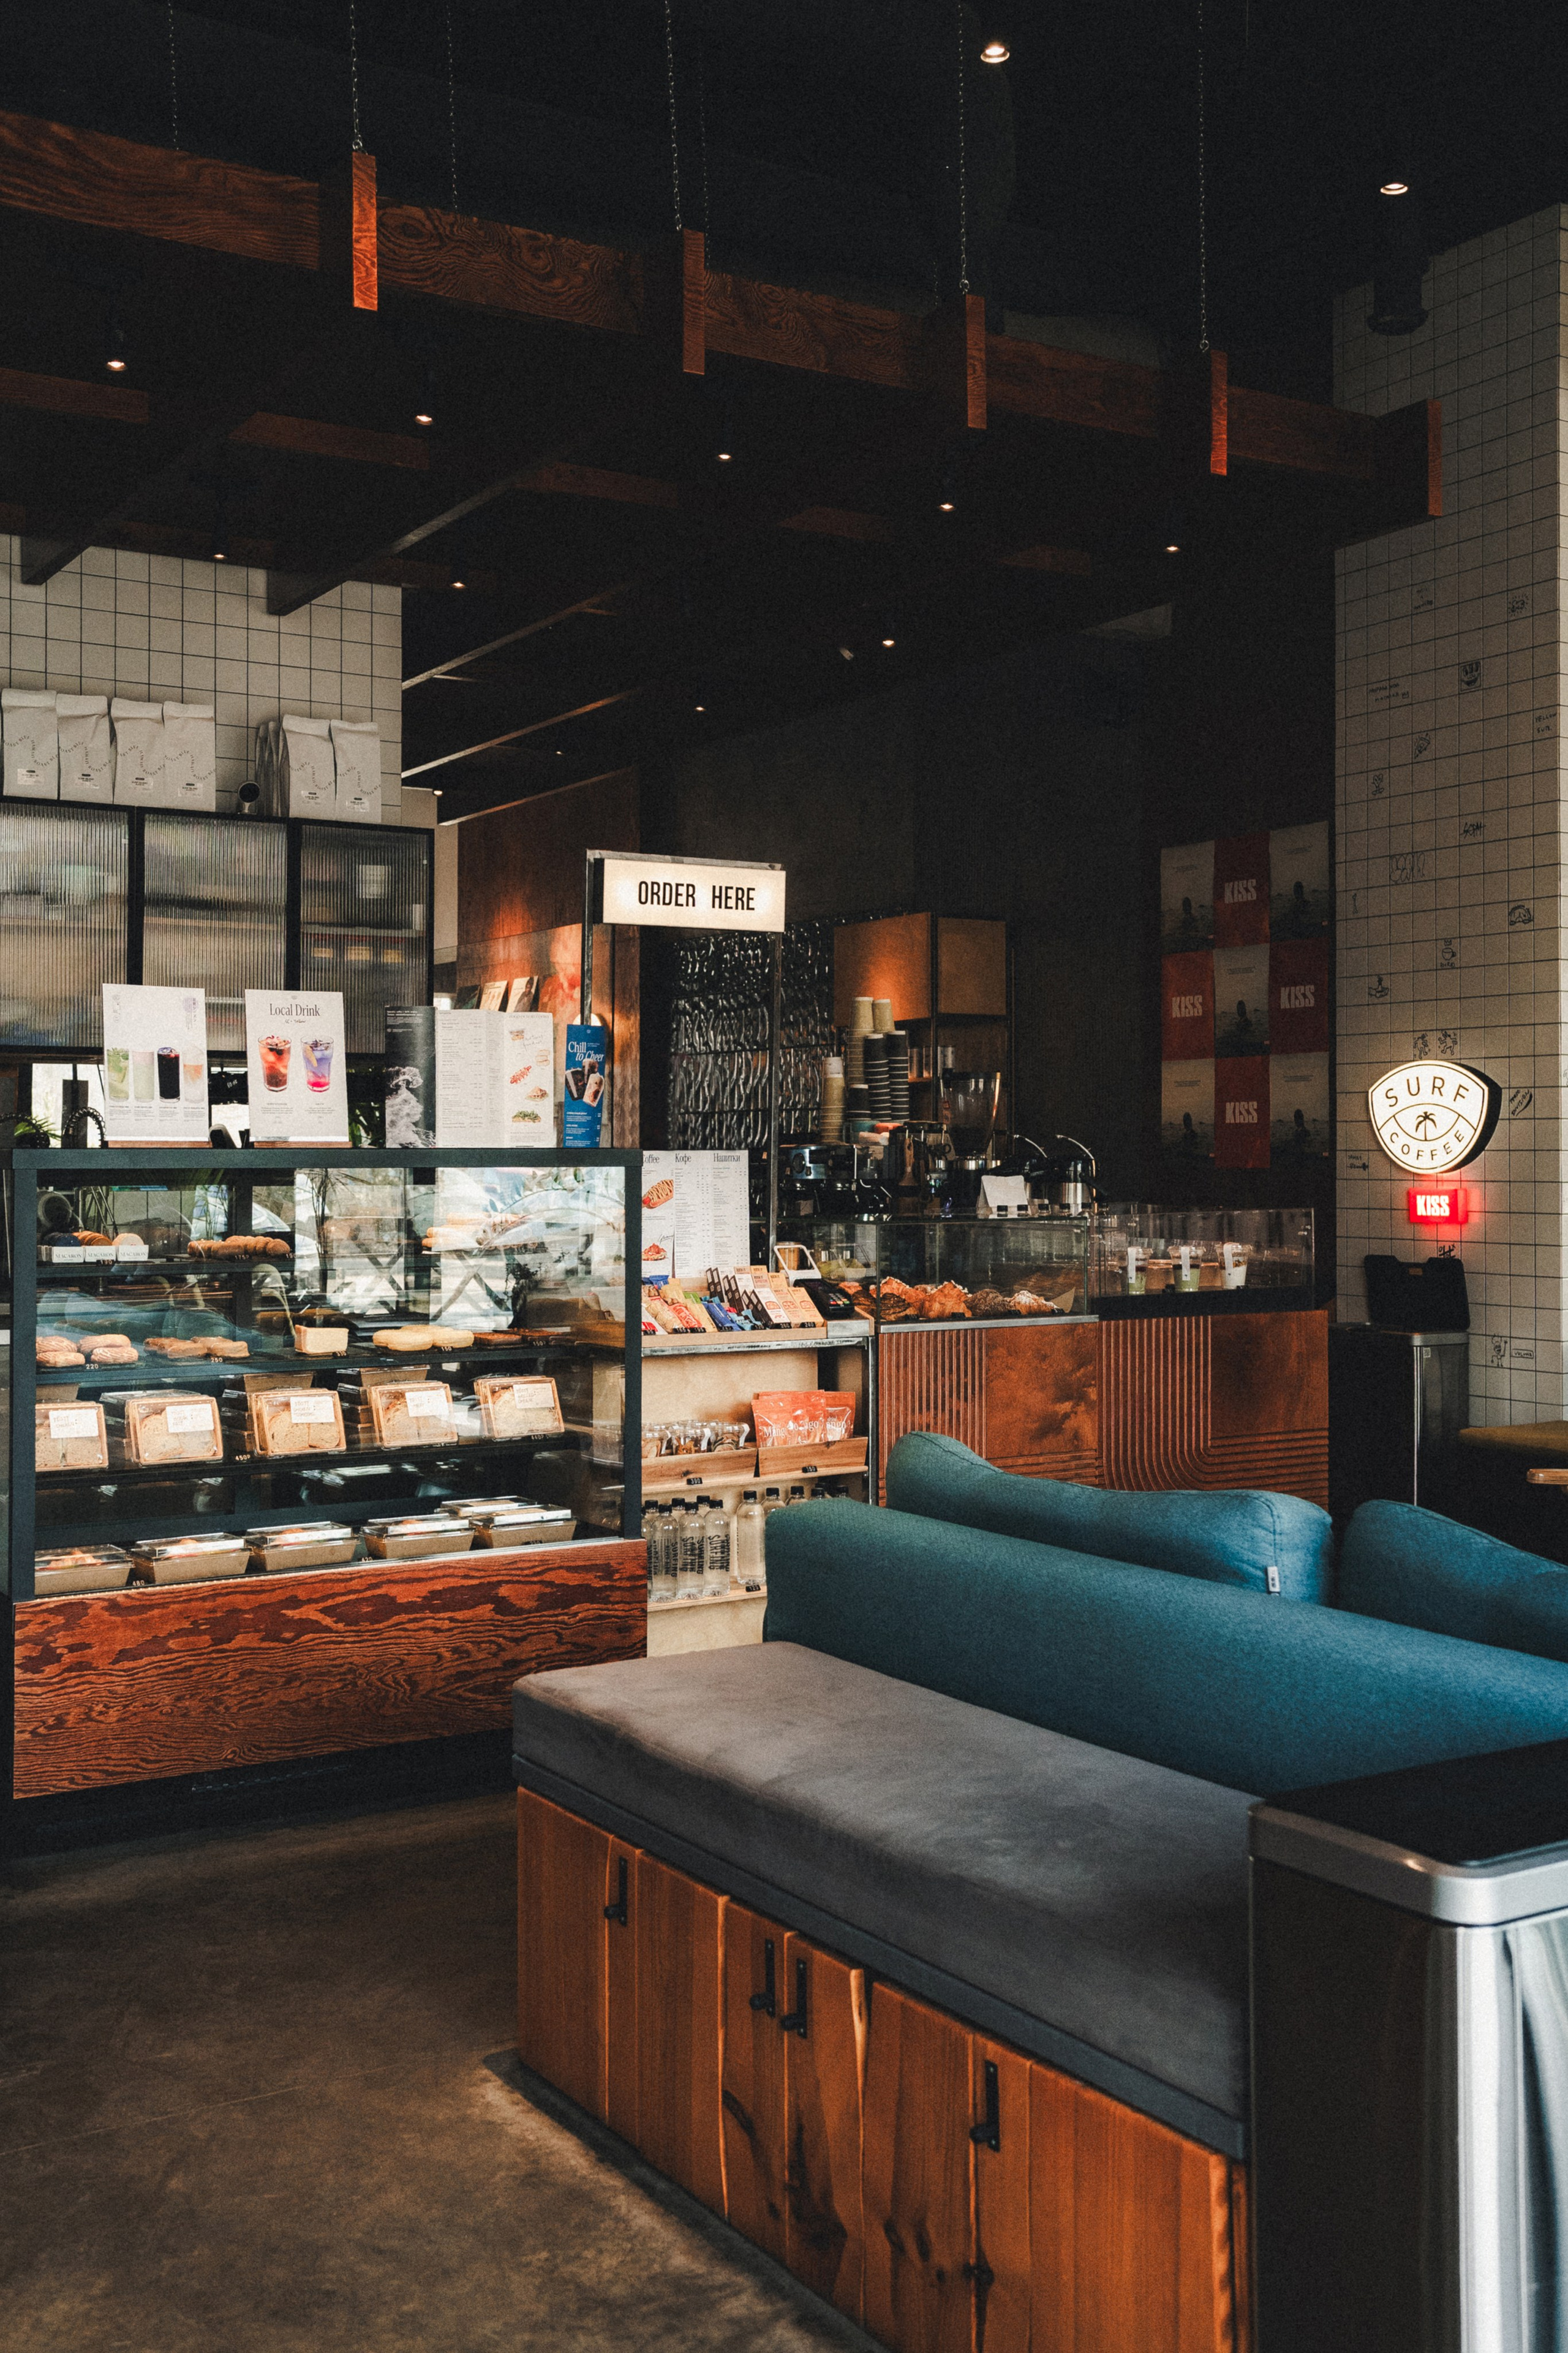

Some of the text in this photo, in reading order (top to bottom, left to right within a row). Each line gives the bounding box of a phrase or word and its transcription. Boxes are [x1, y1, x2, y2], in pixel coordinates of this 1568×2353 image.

[638, 881, 755, 911] ORDER HERE
[1224, 878, 1257, 904] KISS
[1172, 995, 1203, 1019] KISS
[1280, 985, 1314, 1009] KISS
[270, 1003, 320, 1017] Local Drink
[568, 1041, 586, 1053] Chill
[576, 1050, 604, 1062] to Cheer
[1385, 1076, 1469, 1108] SURF
[1226, 1101, 1258, 1124] KISS
[1389, 1130, 1464, 1161] COFFEE
[675, 1153, 692, 1165] Кофе
[713, 1153, 741, 1163] Напитки
[1416, 1195, 1450, 1217] KISS
